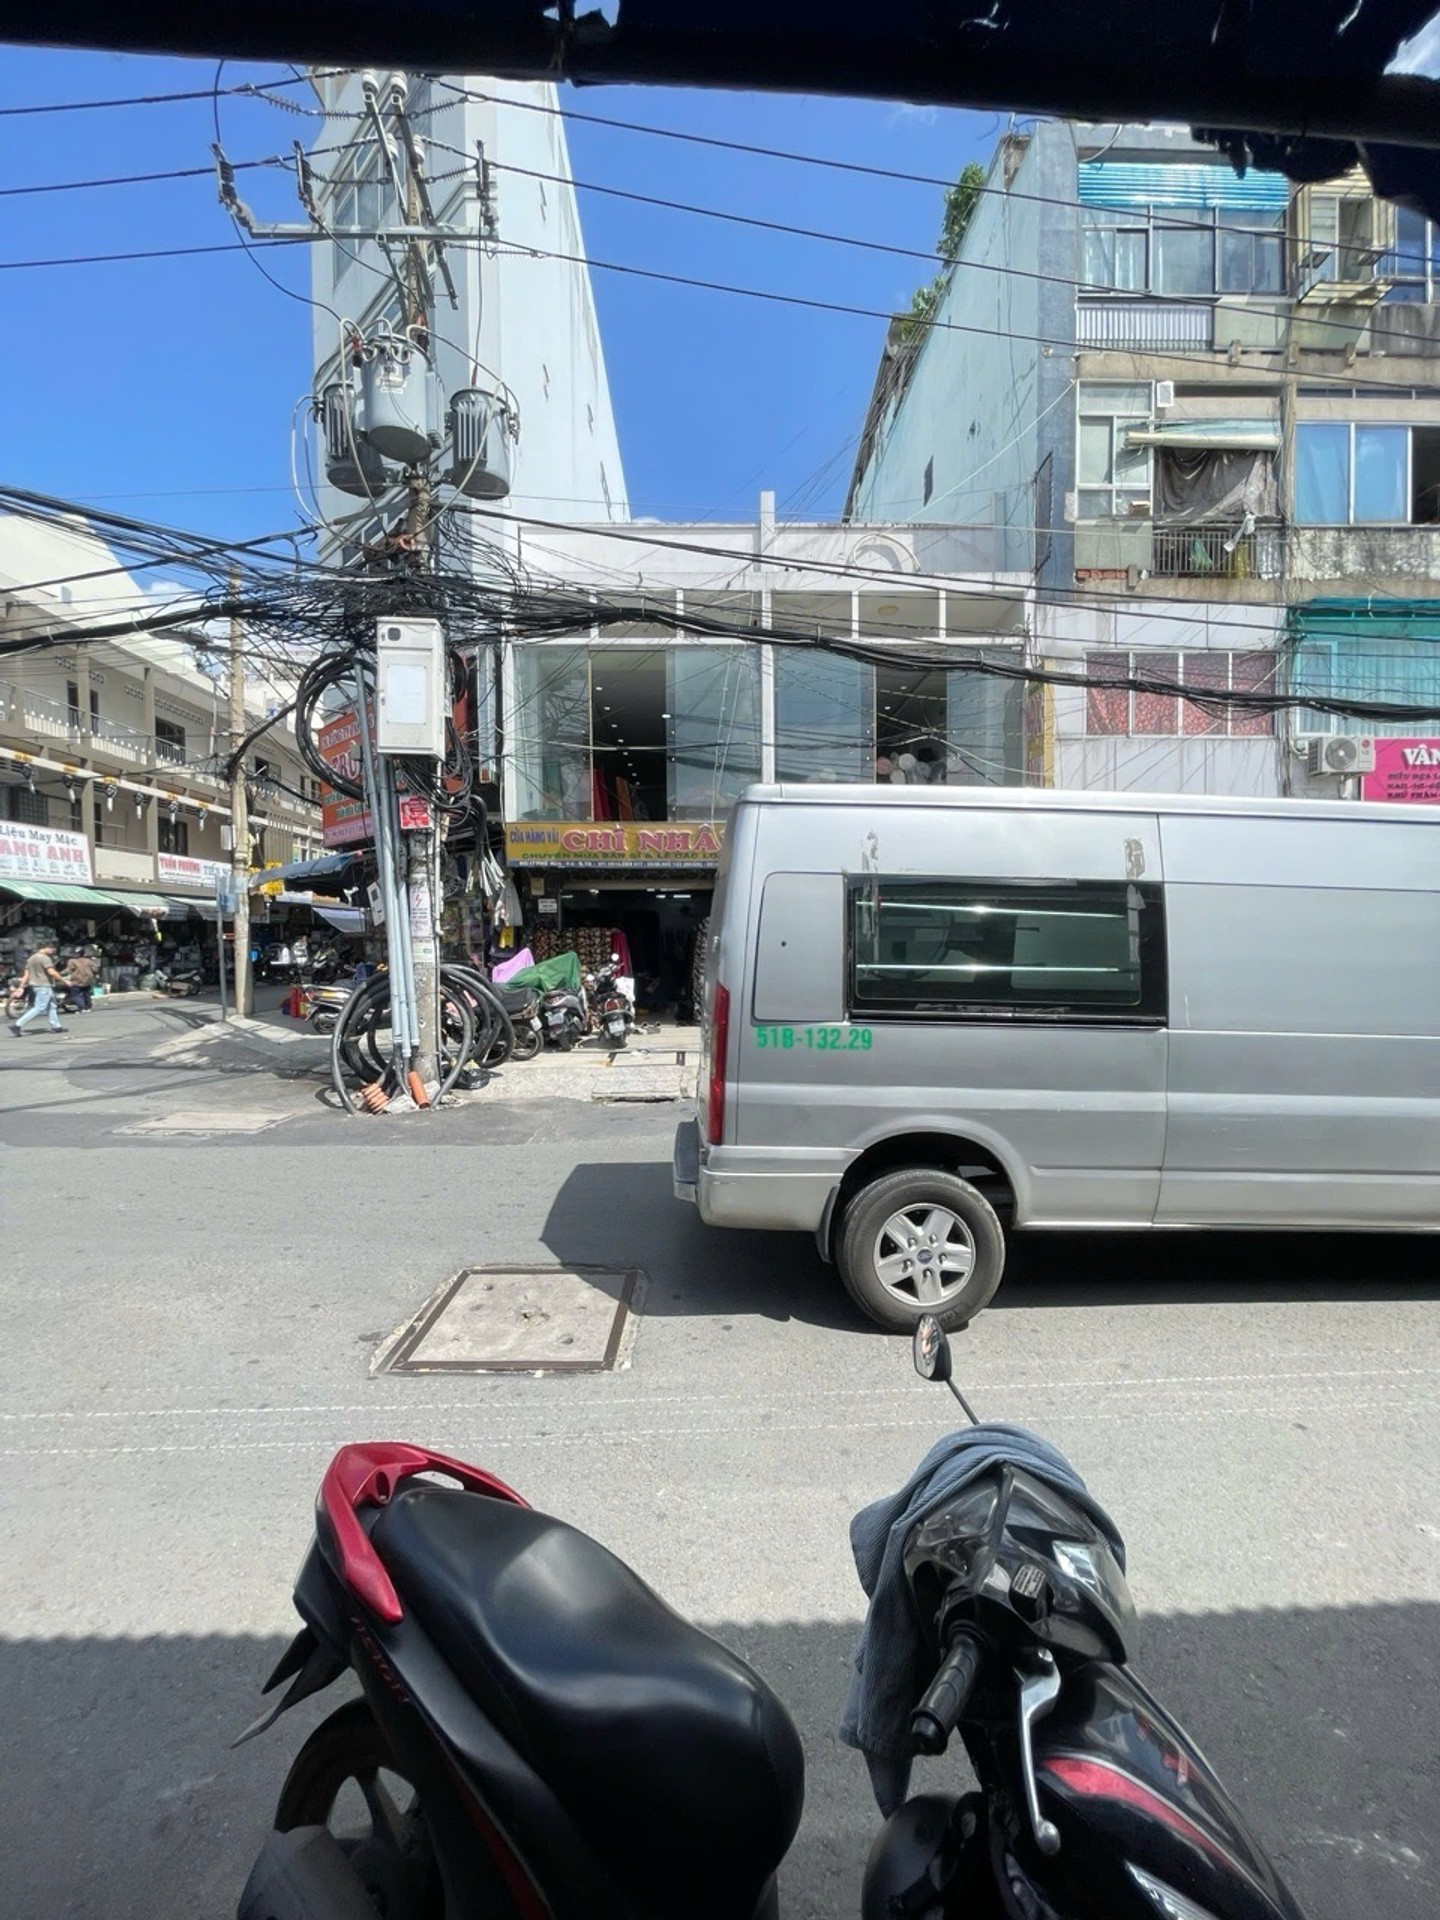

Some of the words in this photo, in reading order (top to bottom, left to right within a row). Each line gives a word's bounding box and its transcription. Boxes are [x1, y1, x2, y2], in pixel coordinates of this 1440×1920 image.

[0, 825, 25, 838] Liệu
[28, 829, 52, 844] May
[637, 823, 724, 852] NHÂ
[756, 1027, 873, 1050] 51B-132.29
